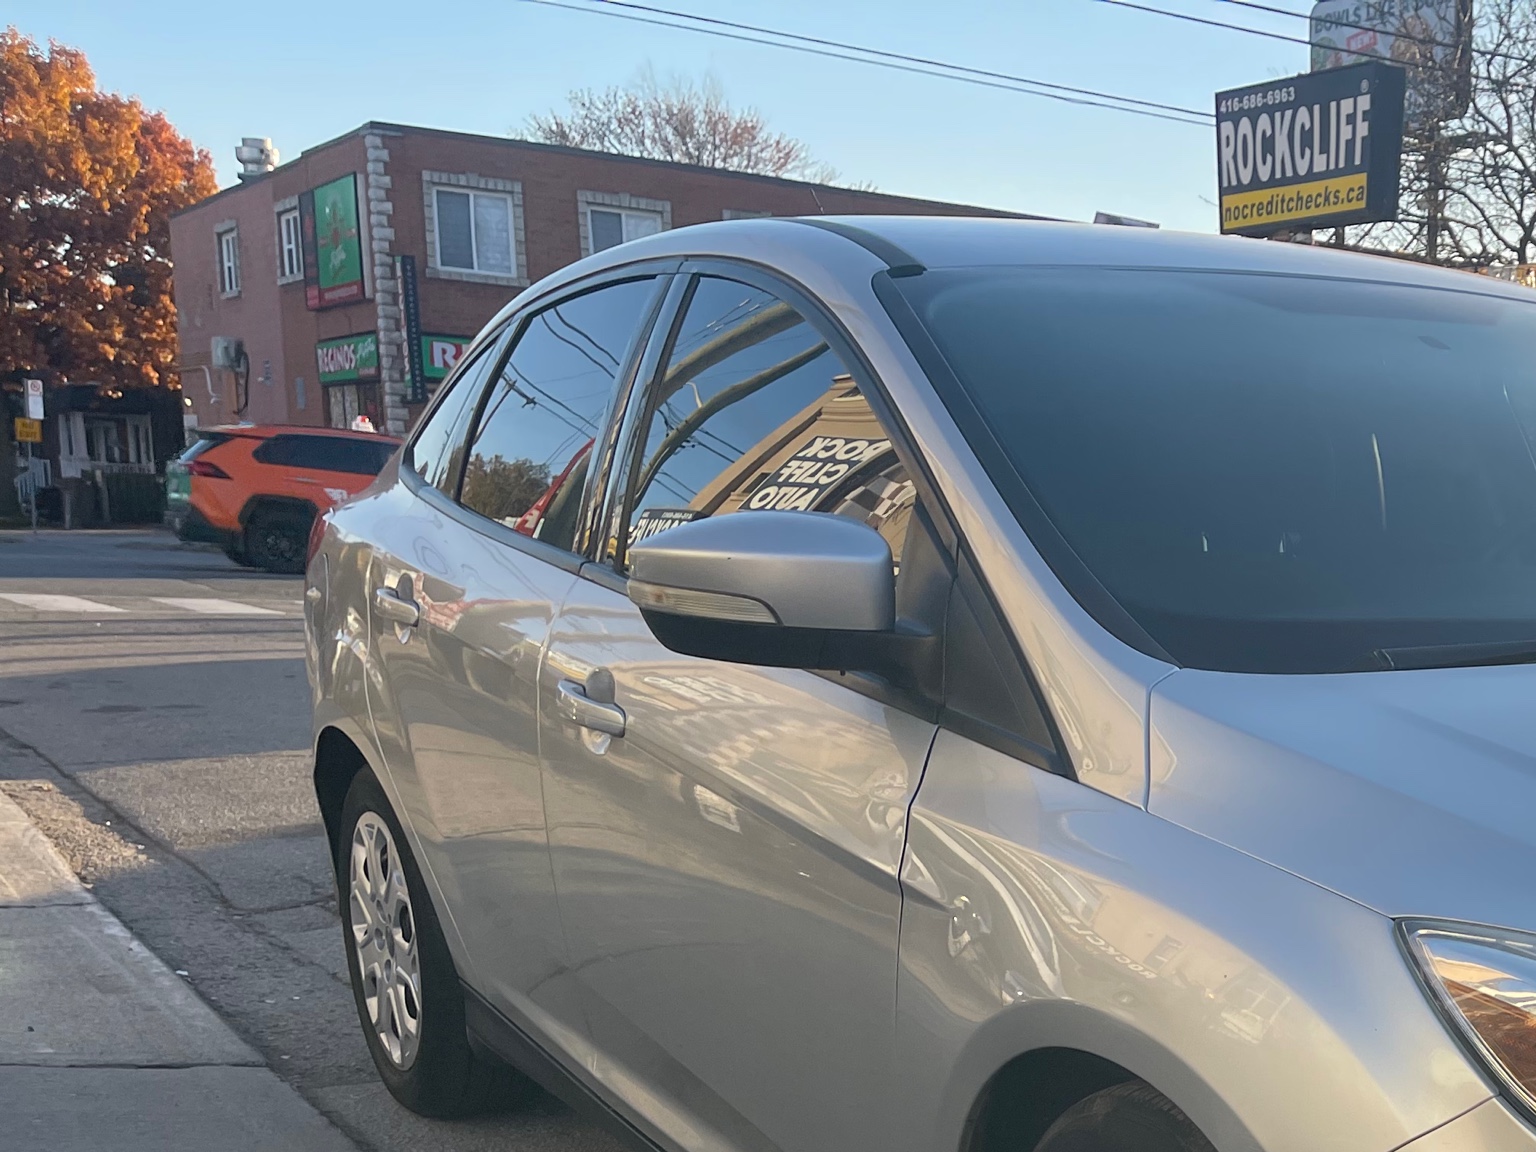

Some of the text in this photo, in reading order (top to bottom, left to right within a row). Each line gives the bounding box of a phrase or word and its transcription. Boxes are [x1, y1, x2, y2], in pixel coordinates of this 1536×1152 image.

[1220, 86, 1295, 113] 416-686-6963
[1220, 93, 1371, 188] ROCKCLIFF
[1224, 184, 1365, 222] nocreditchecks.ca
